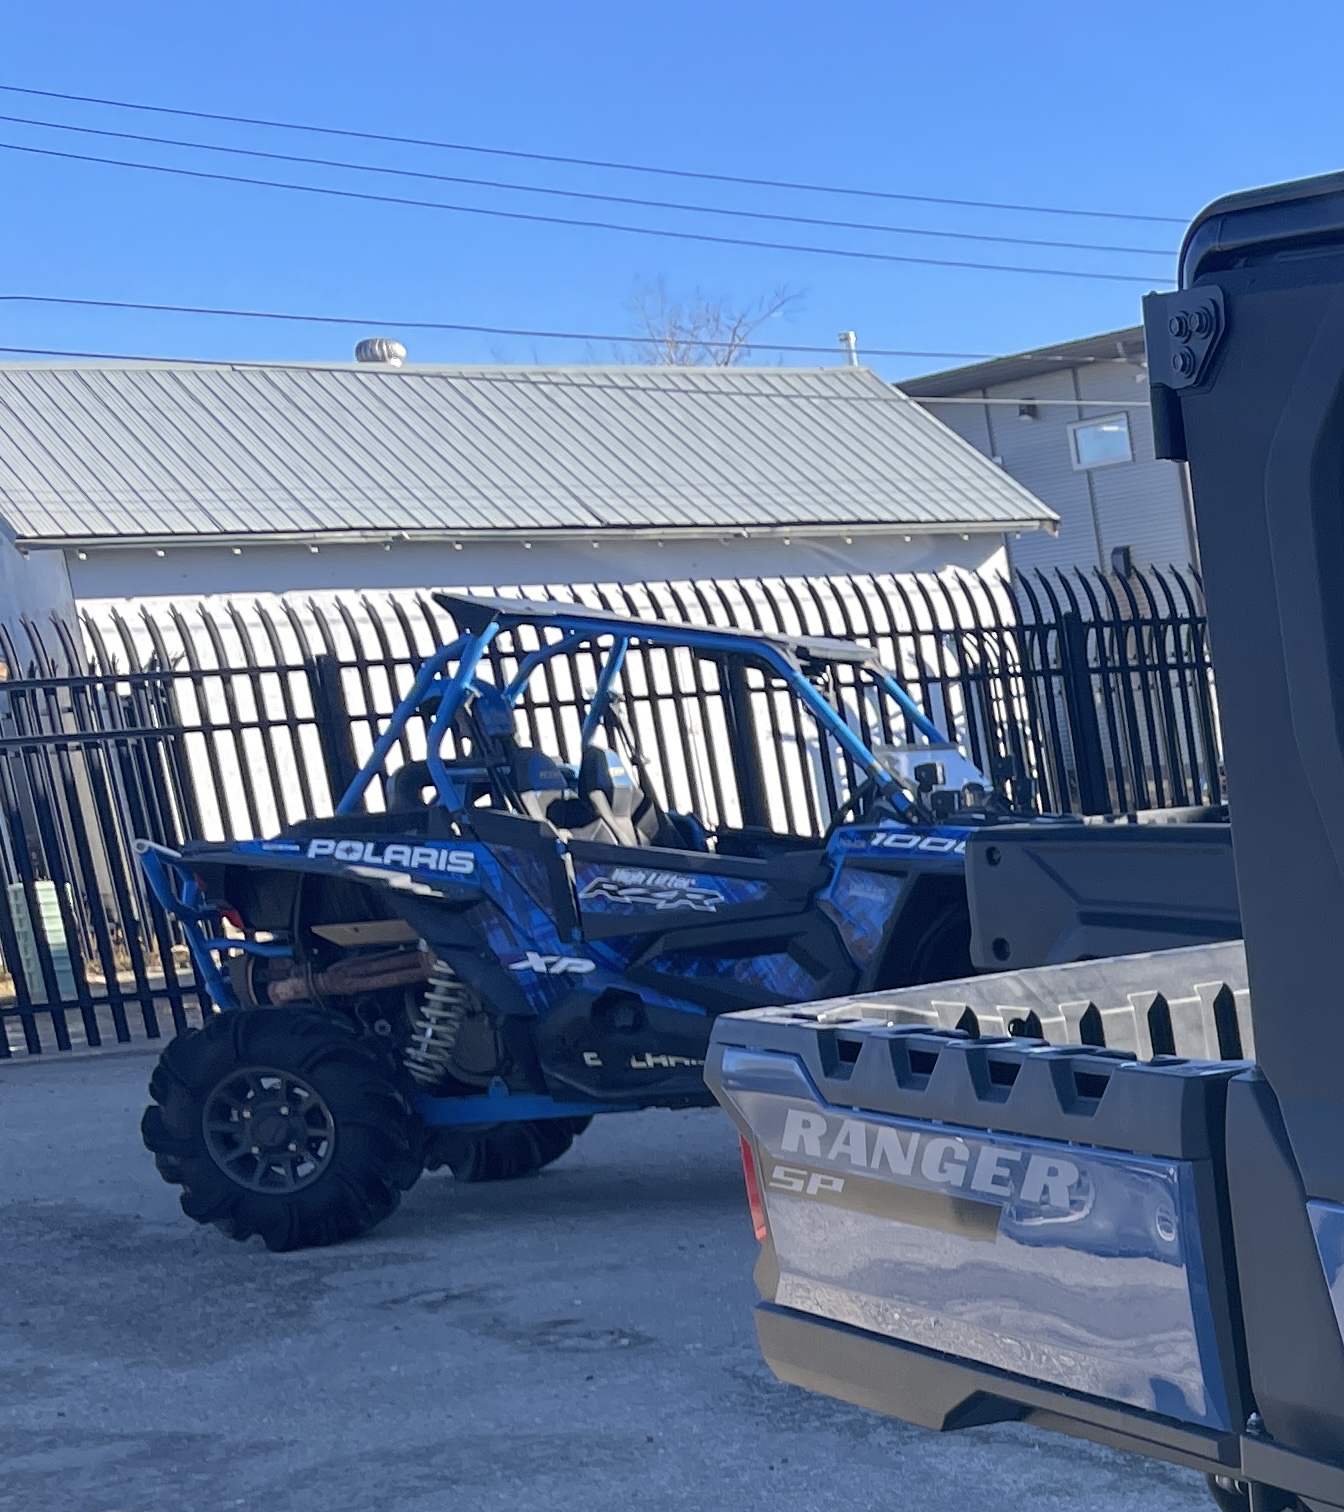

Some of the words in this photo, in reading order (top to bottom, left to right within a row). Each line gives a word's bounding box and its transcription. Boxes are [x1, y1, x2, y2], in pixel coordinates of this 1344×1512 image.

[306, 838, 476, 875] POLARIS
[508, 950, 596, 975] XP
[779, 1107, 1081, 1209] RANGER
[768, 1164, 845, 1196] SP
